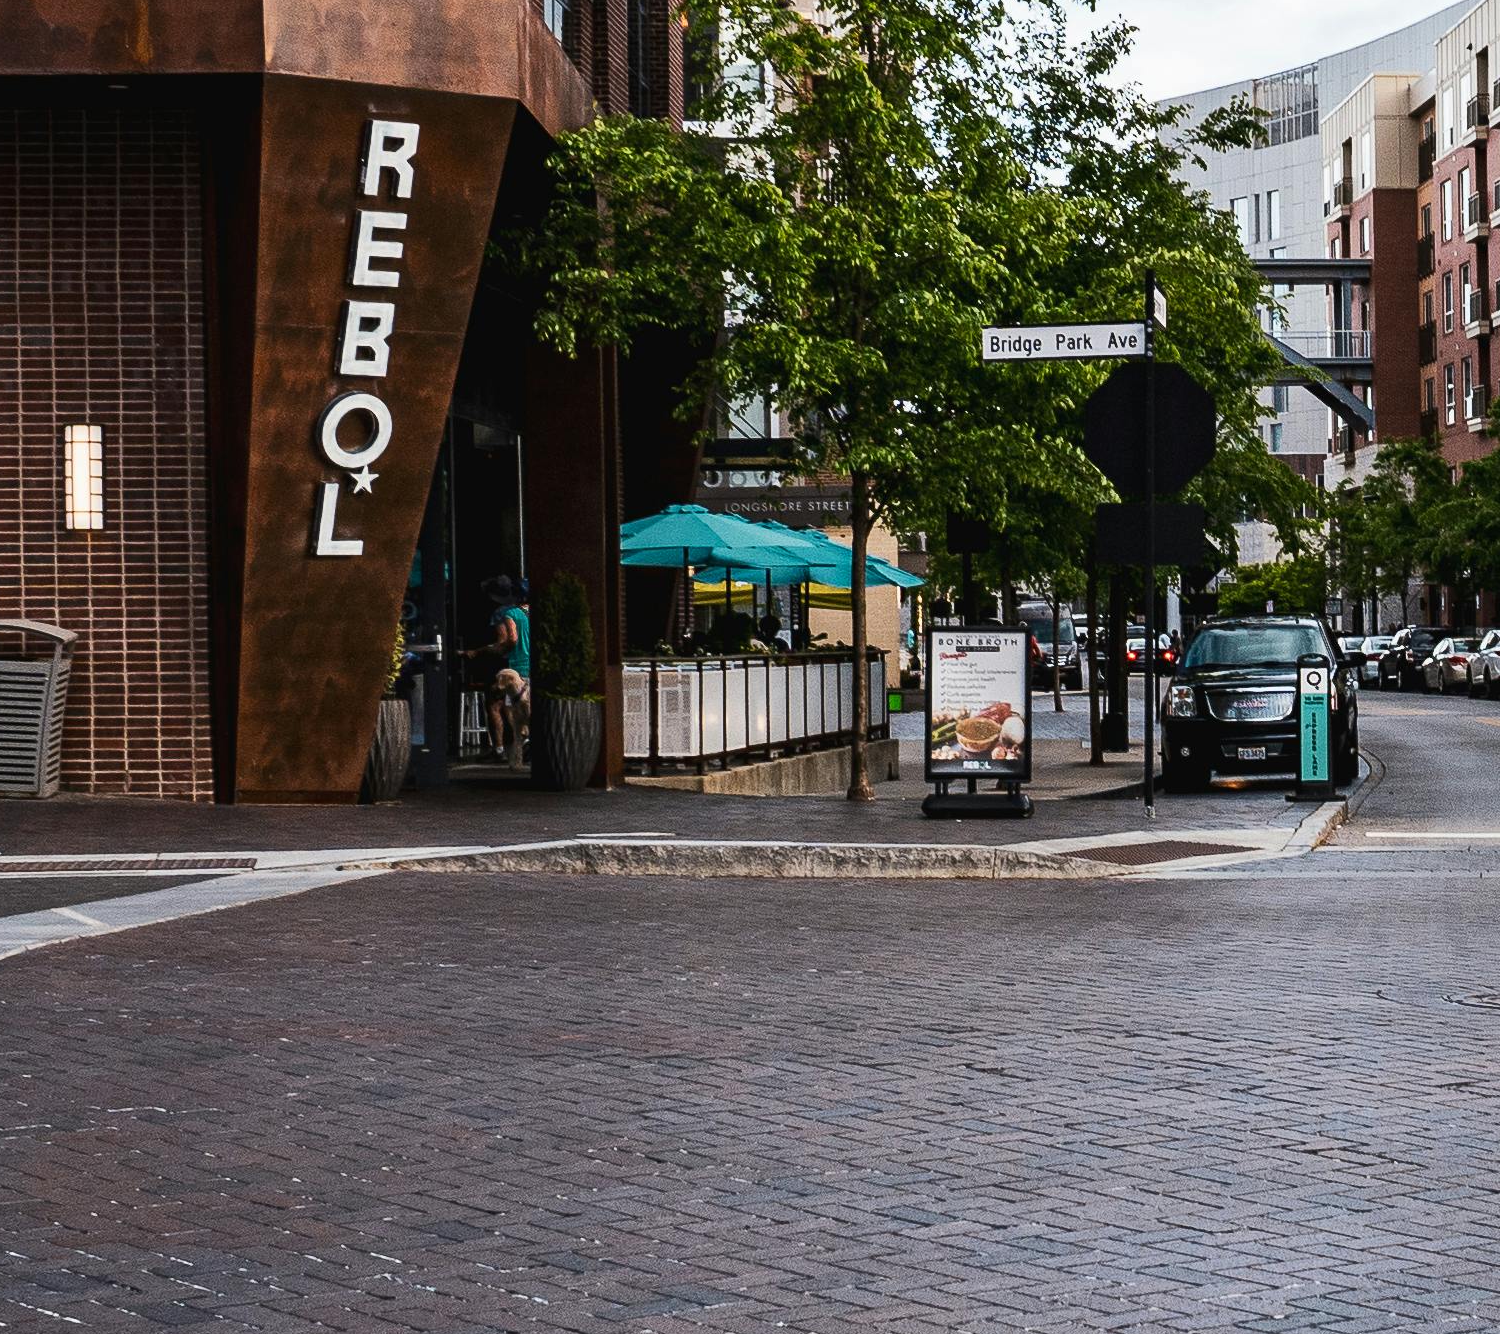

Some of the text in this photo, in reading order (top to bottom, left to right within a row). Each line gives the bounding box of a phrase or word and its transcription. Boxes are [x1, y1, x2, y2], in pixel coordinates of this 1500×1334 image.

[314, 119, 420, 556] REBOL
[990, 332, 1138, 356] Bridge Park Ave
[808, 500, 851, 512] STREET
[938, 638, 1018, 646] BONE BROTH
[1306, 671, 1322, 690] Q
